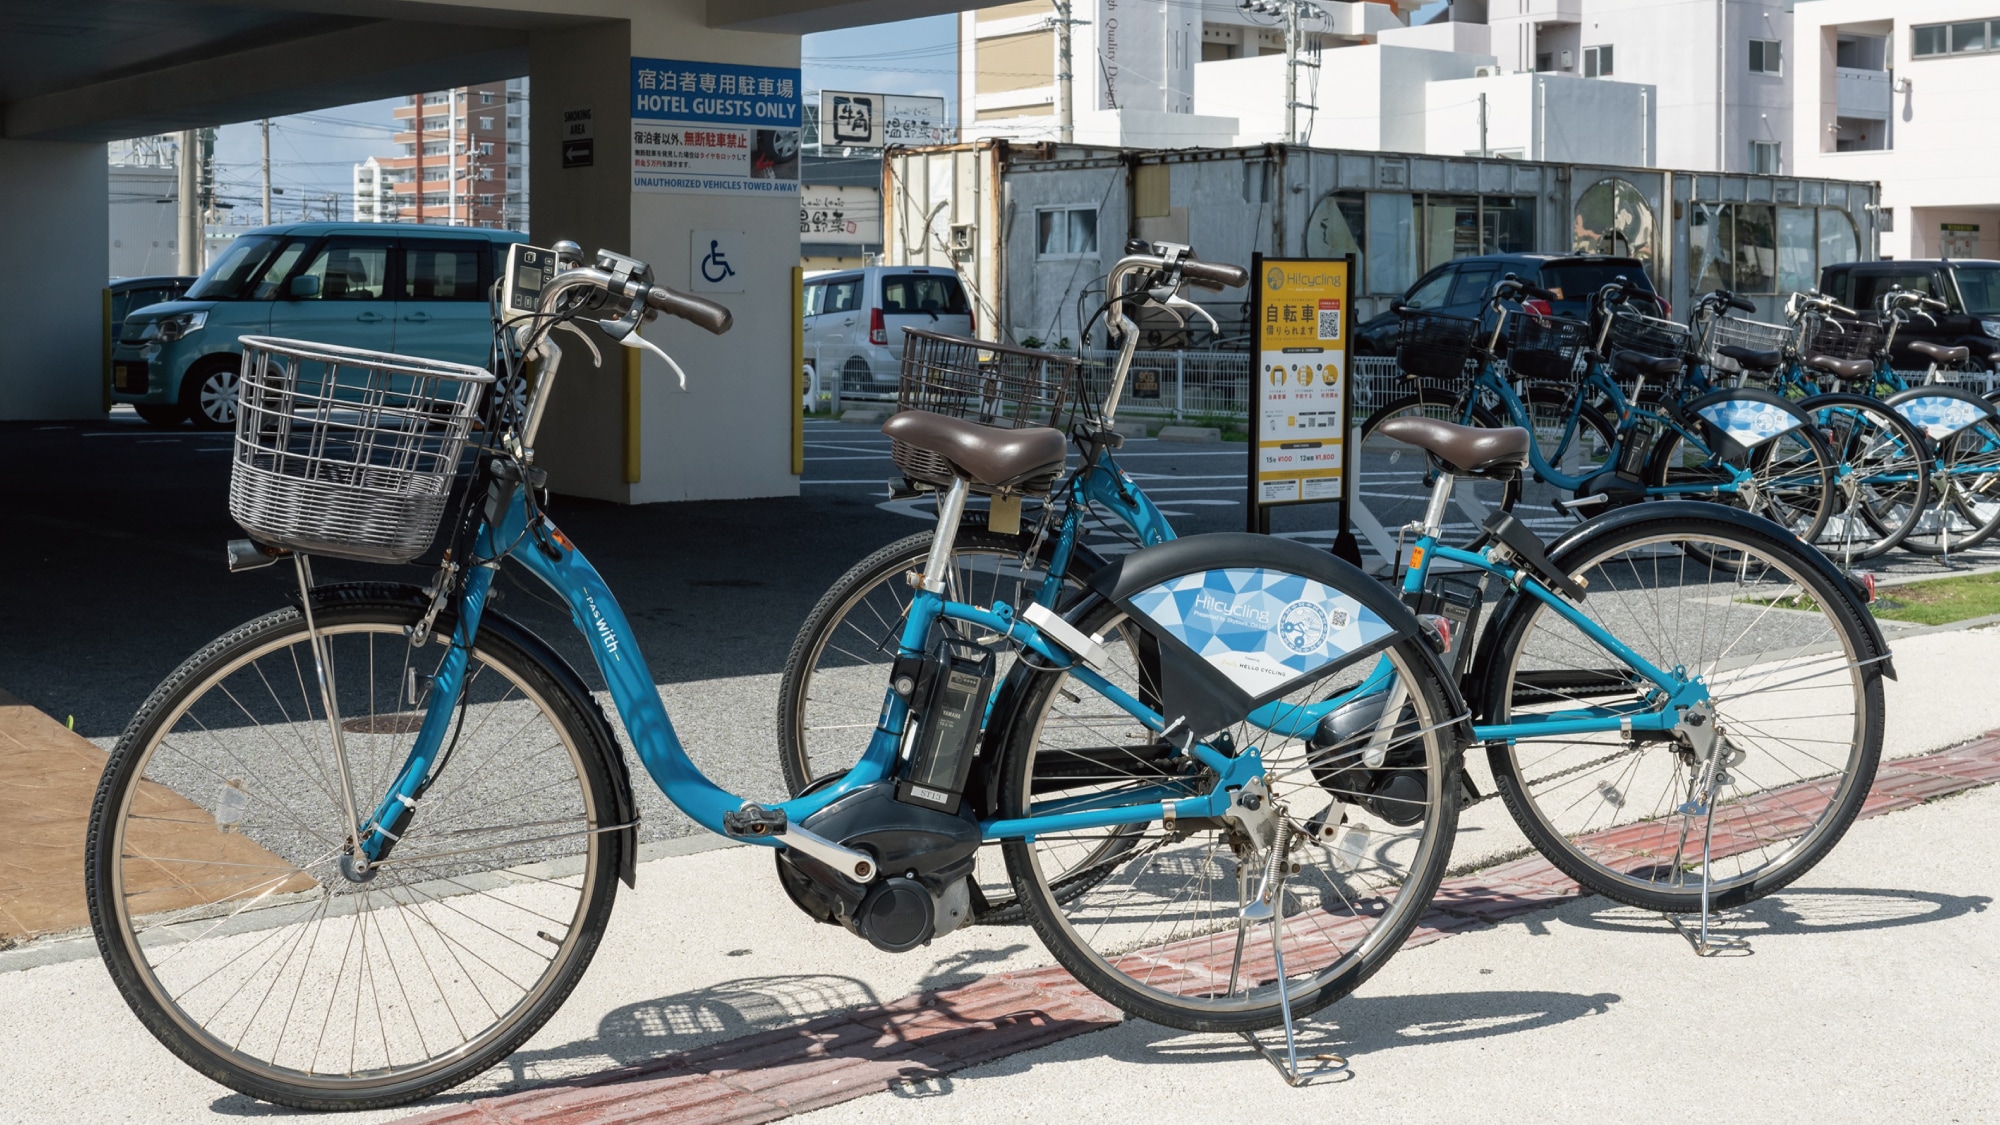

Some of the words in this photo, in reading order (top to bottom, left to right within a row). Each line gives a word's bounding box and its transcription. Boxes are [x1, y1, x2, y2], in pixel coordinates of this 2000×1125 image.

[1105, 18, 1118, 61] Quality
[638, 69, 794, 98] 宿泊者専用駐車場
[637, 95, 689, 113] HOTEL
[692, 98, 752, 117] GUESTS
[755, 102, 796, 119] ONLY
[564, 109, 591, 123] SMOKING
[838, 105, 868, 132] 牛角
[570, 124, 586, 135] AREA
[885, 117, 931, 140] 温野菜
[634, 131, 748, 149] 宿泊者以外、無断駐車禁止
[634, 149, 747, 161] 無断駐車を発見した場合はタイヤをロックして
[634, 177, 701, 188] UNAUTHORIZED
[703, 180, 742, 190] VEHICLES
[743, 182, 772, 191] TOWED
[773, 183, 798, 192] AWAY
[1266, 304, 1315, 323] 自転車
[1266, 325, 1315, 336] 借りられます
[1193, 610, 1219, 620] Presented
[586, 596, 600, 619] PAS
[596, 617, 619, 653] with
[1239, 663, 1260, 671] HELLO
[1260, 667, 1286, 677] CYCLING
[942, 710, 961, 719] YAMAHA
[920, 789, 942, 801] ST13
